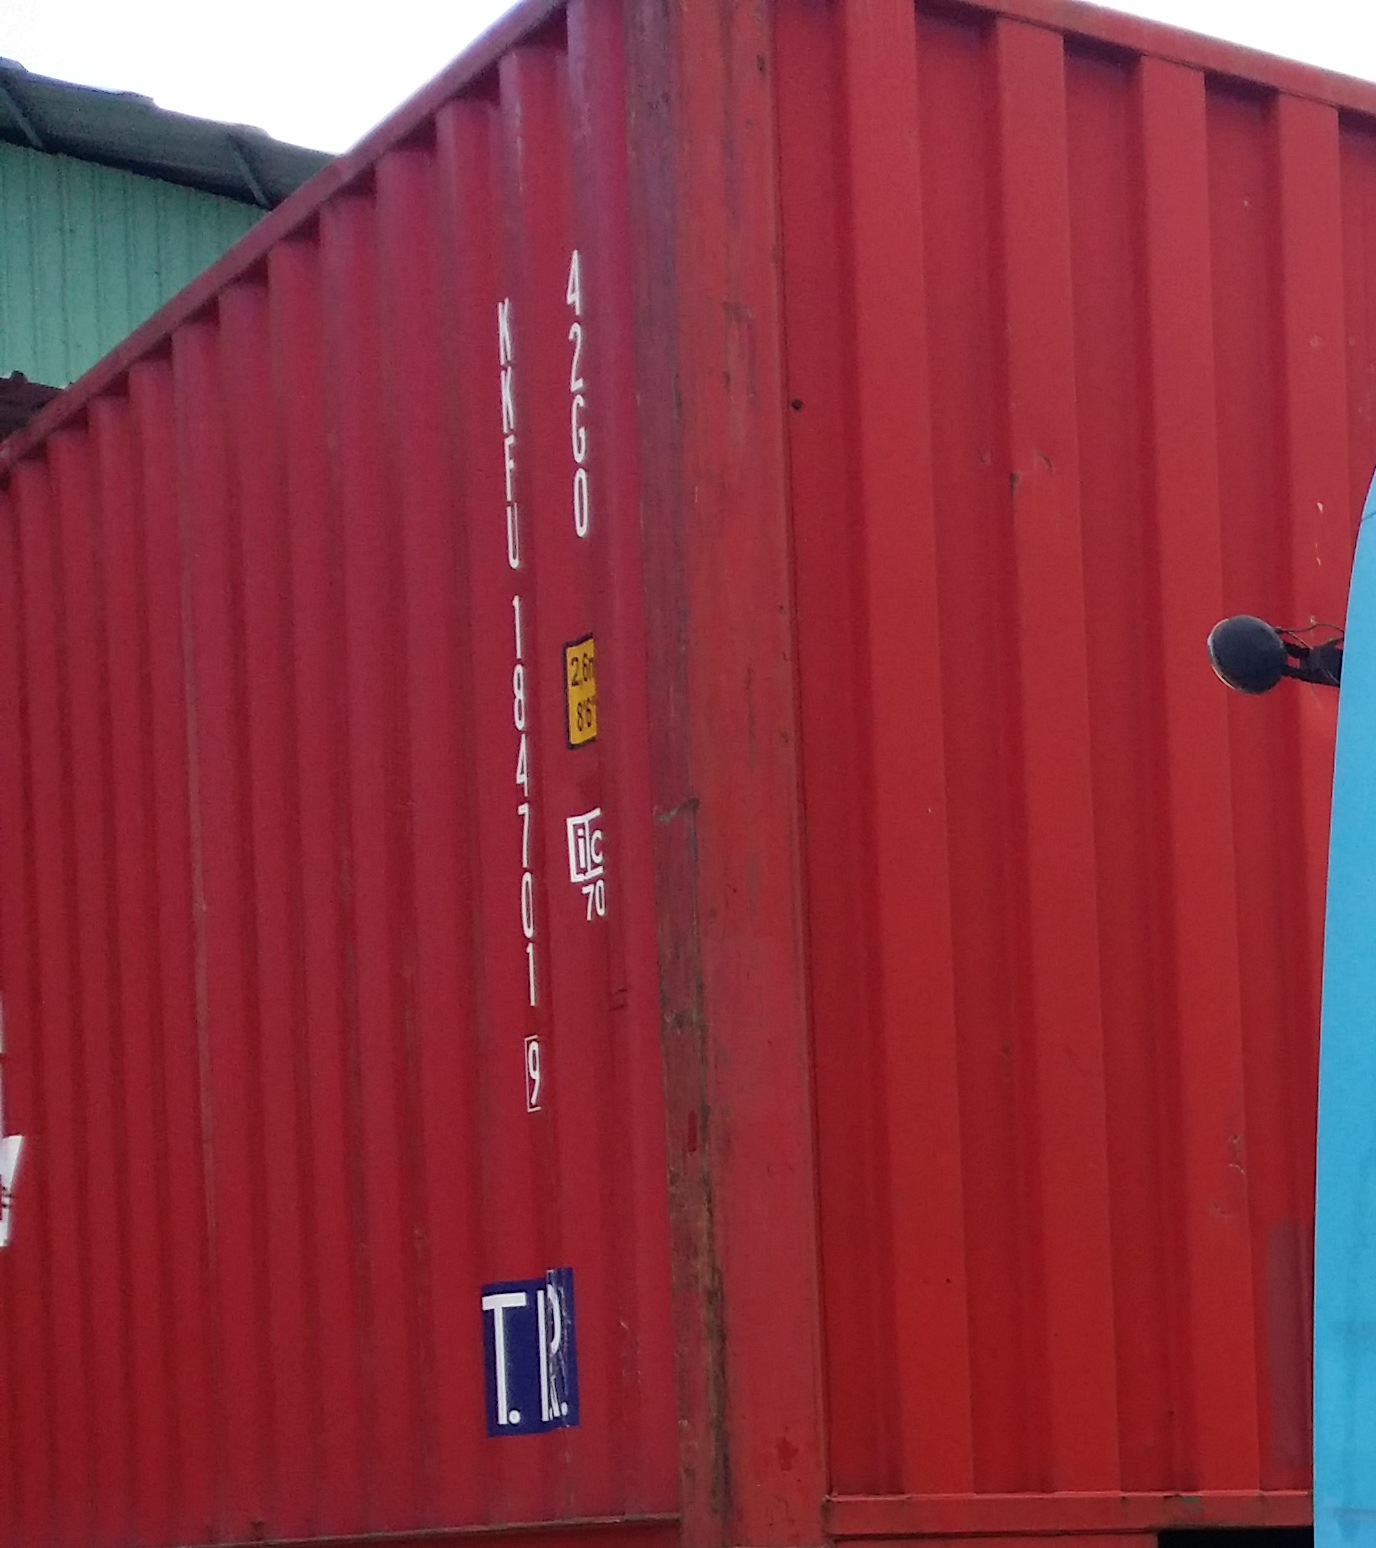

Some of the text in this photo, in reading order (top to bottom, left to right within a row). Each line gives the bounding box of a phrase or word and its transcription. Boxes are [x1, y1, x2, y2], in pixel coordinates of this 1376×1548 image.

[566, 249, 589, 538] 42G0
[510, 594, 536, 1006] 184701
[581, 879, 605, 921] 70
